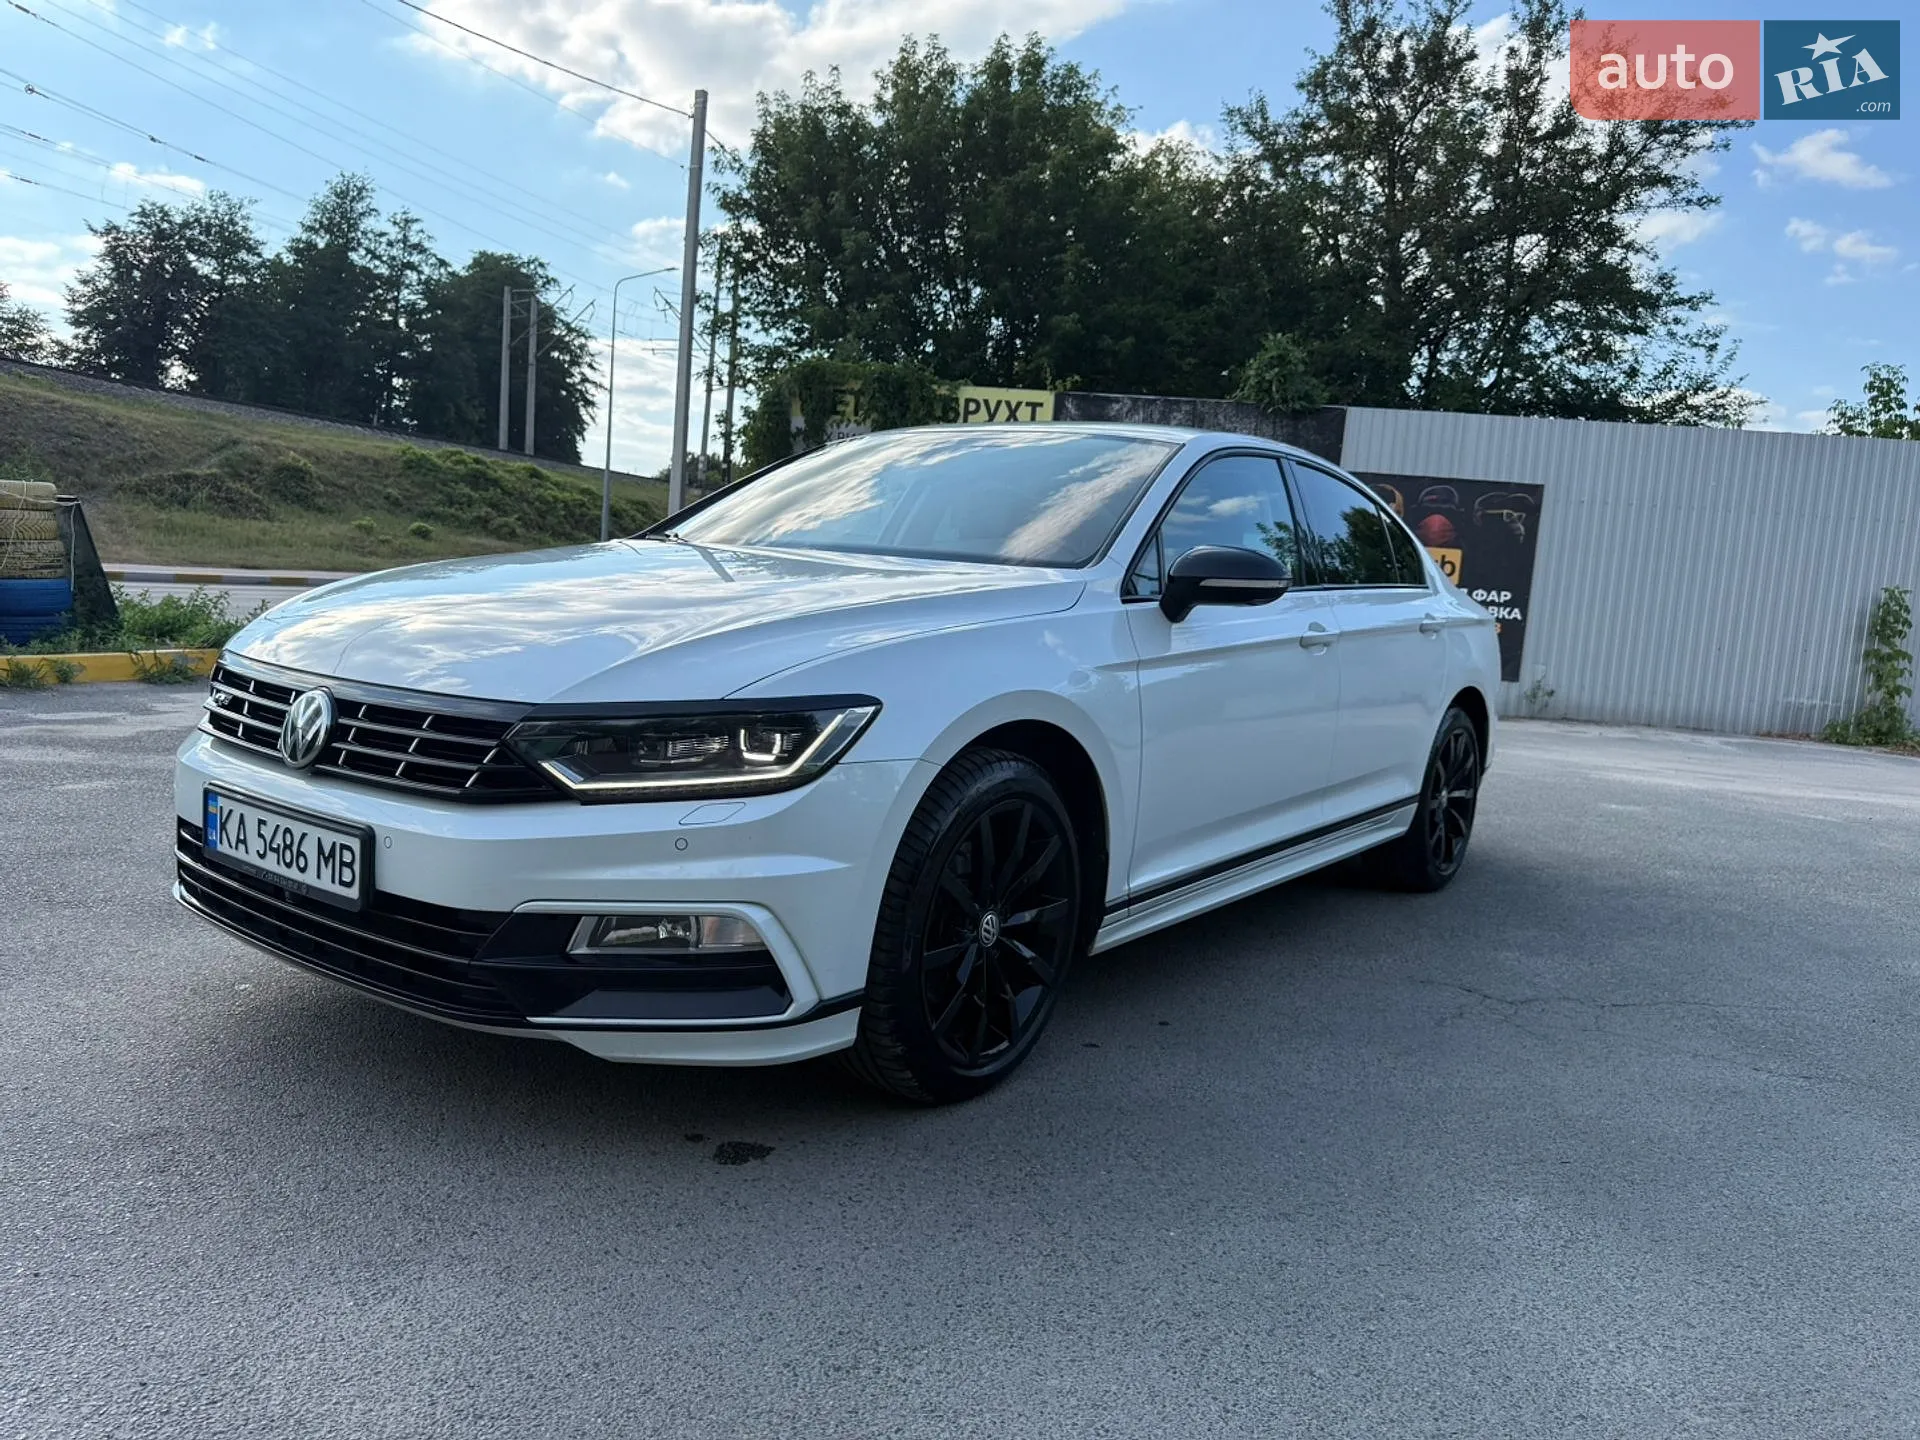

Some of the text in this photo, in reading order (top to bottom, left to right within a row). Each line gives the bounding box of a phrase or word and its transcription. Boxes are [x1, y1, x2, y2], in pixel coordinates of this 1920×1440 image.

[1472, 588, 1512, 603] ФАР
[219, 806, 249, 855] KA
[256, 817, 309, 875] 5486
[316, 837, 356, 888] MB
